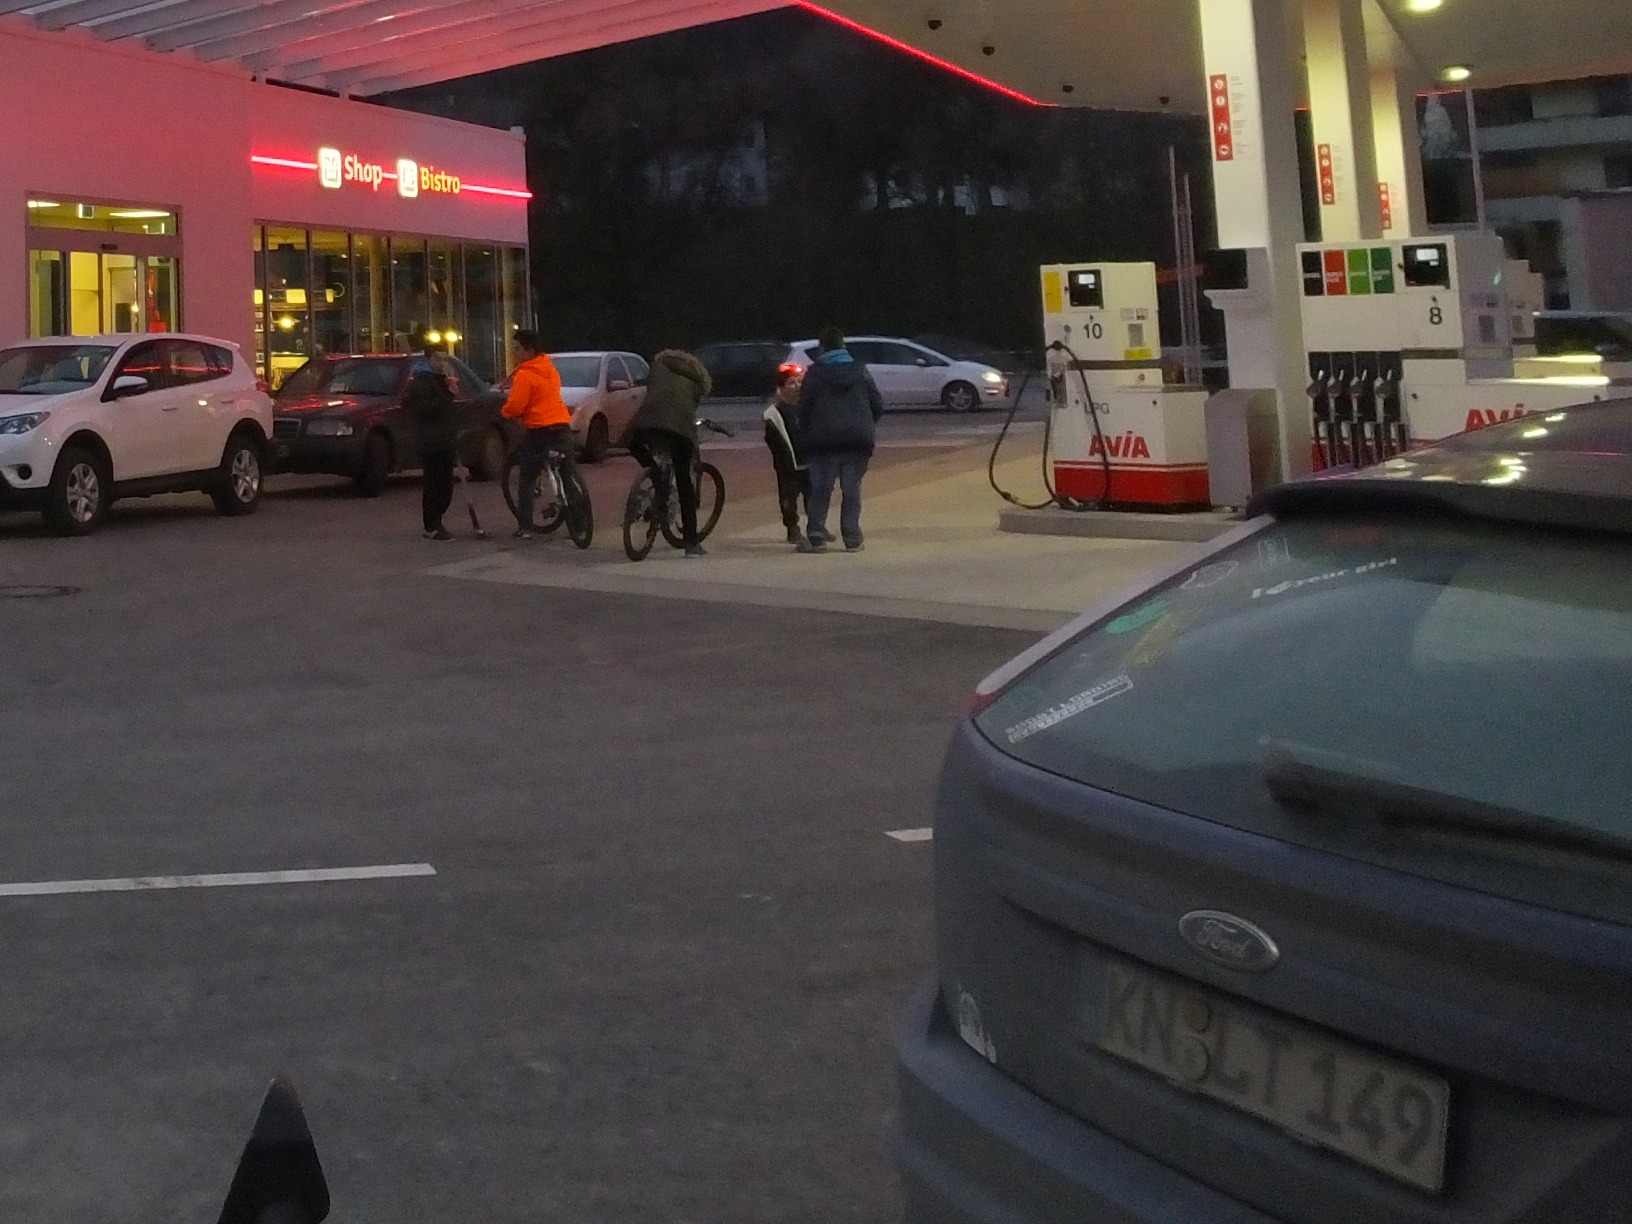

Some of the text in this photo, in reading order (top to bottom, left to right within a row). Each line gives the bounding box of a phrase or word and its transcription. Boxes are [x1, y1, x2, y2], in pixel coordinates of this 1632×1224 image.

[344, 154, 382, 191] Shop
[420, 166, 461, 194] Bistro
[1428, 306, 1443, 325] 8
[1083, 322, 1103, 340] 10
